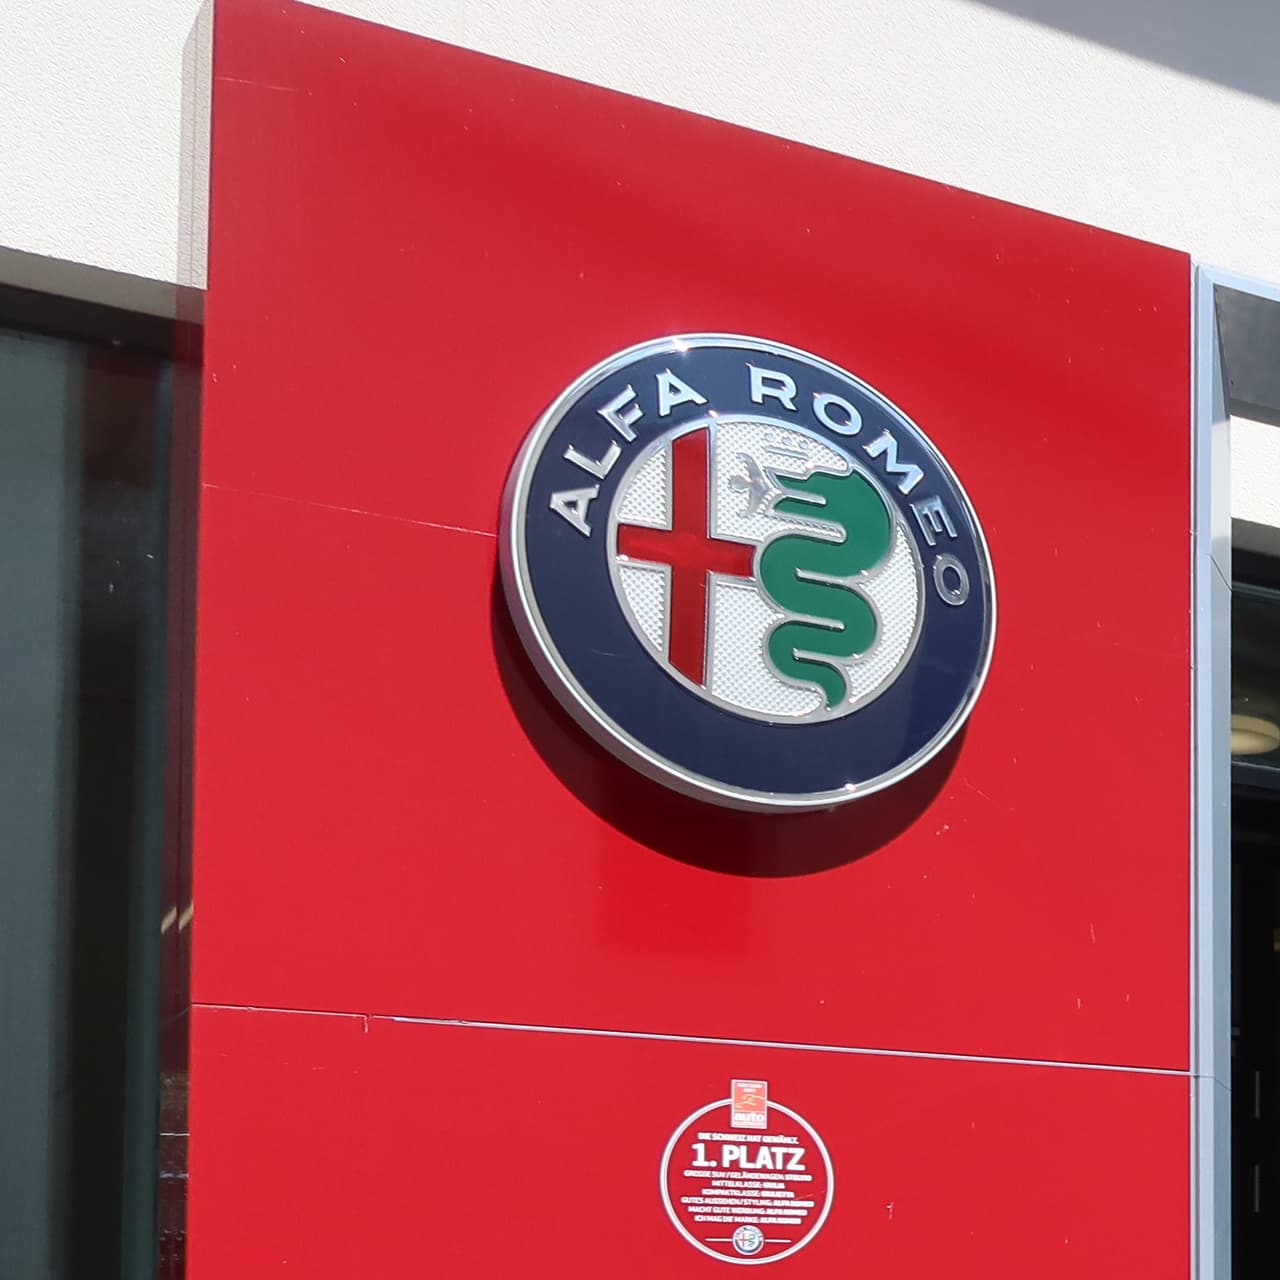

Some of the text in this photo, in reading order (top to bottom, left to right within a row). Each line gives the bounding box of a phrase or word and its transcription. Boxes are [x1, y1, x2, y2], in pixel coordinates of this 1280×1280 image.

[549, 363, 970, 606] ALFA ROMEO
[692, 1143, 805, 1171] 1. PLATZ
